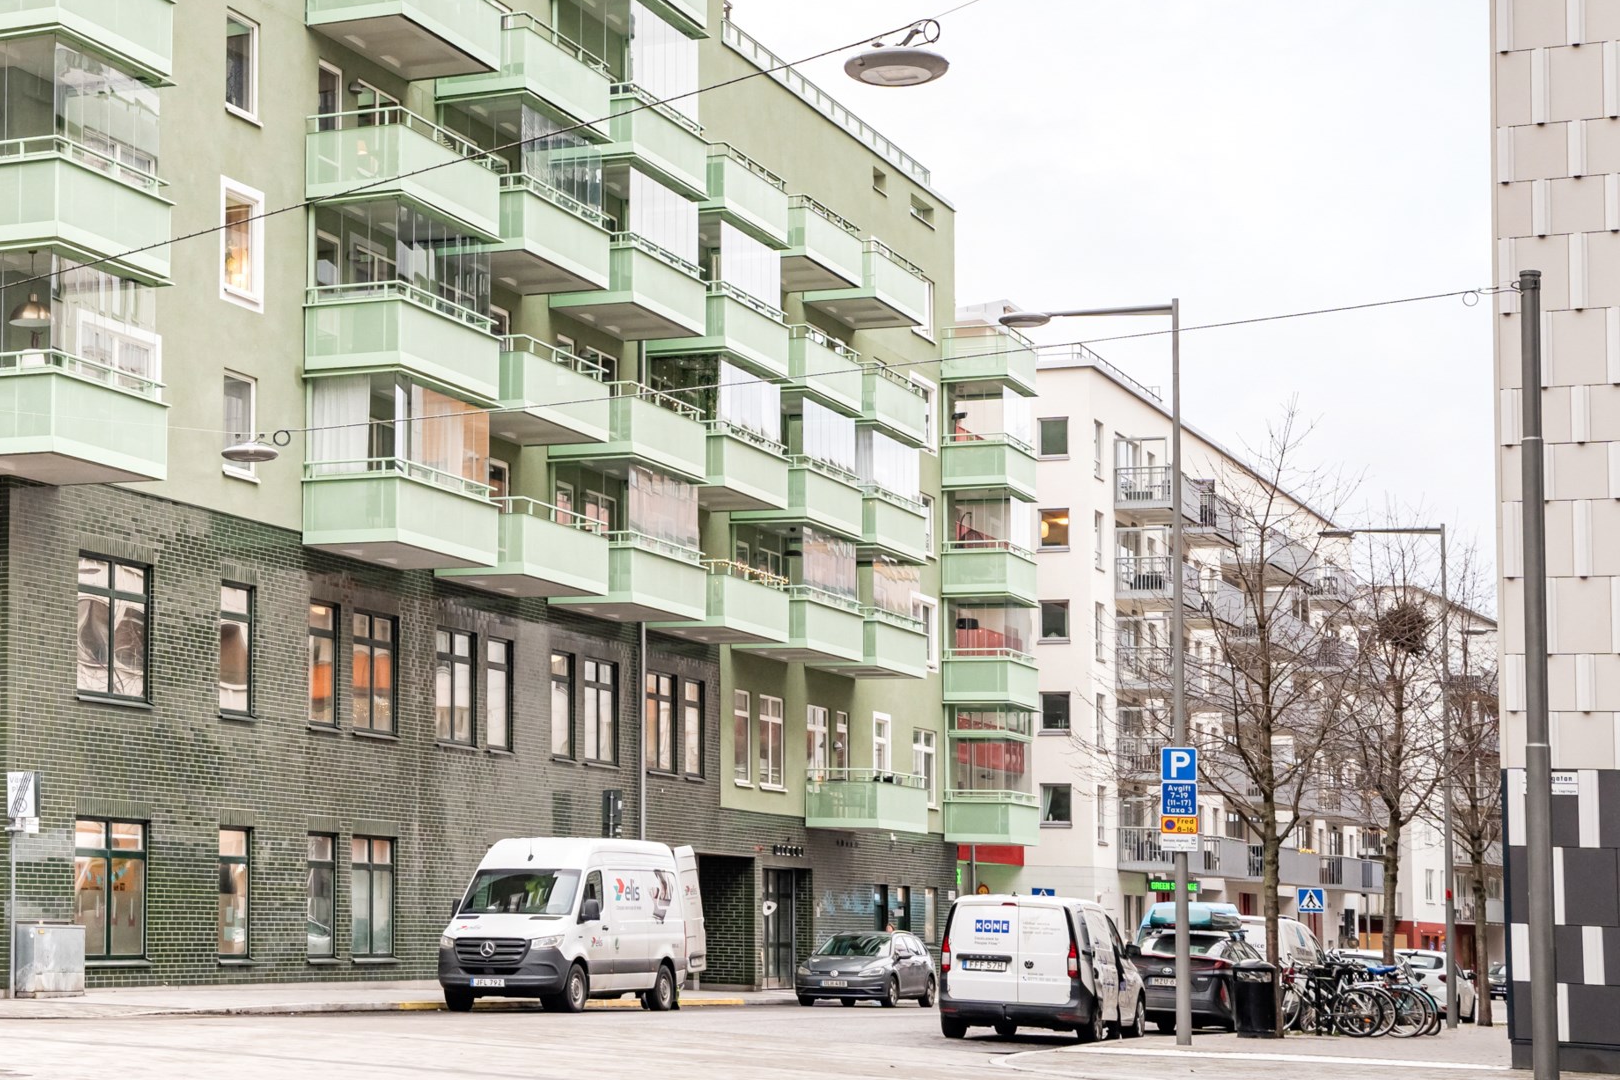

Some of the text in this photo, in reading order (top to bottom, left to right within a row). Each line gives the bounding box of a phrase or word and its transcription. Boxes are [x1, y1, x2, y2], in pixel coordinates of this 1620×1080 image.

[1170, 751, 1191, 778] P
[1551, 775, 1573, 784] gatan
[625, 879, 640, 901] elis
[1151, 881, 1170, 890] GREEN
[975, 921, 1009, 932] KONE
